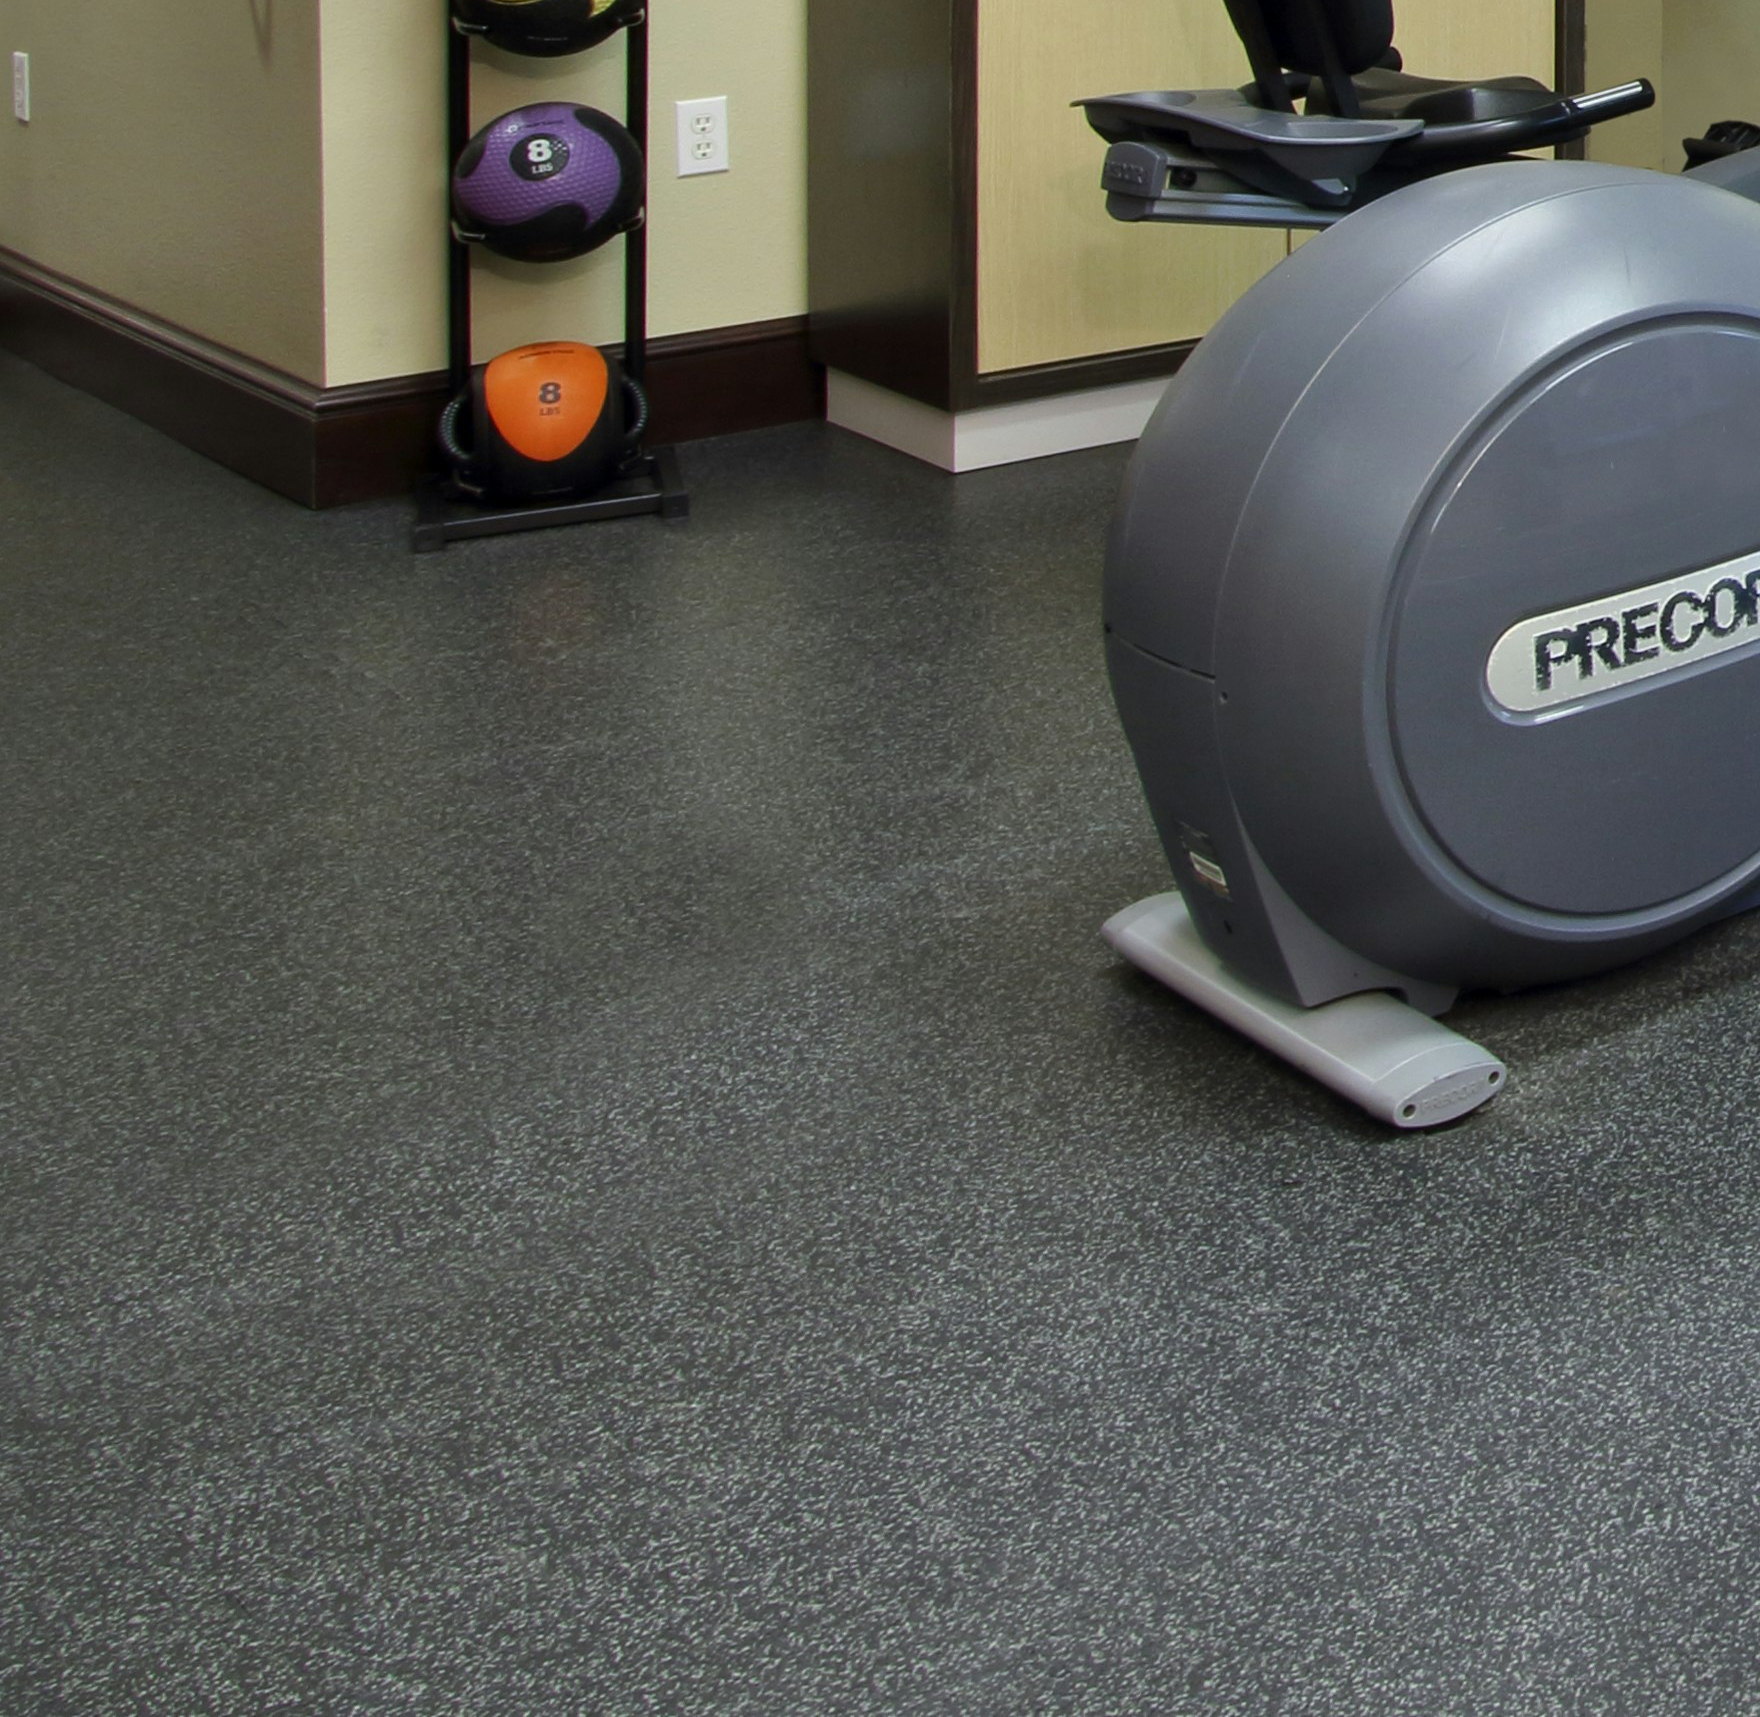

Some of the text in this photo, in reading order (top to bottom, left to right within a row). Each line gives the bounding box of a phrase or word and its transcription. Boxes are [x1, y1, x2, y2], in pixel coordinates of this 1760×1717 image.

[527, 139, 553, 163] 8
[532, 163, 554, 174] LBS
[539, 382, 561, 404] 8
[539, 407, 561, 417] LBS
